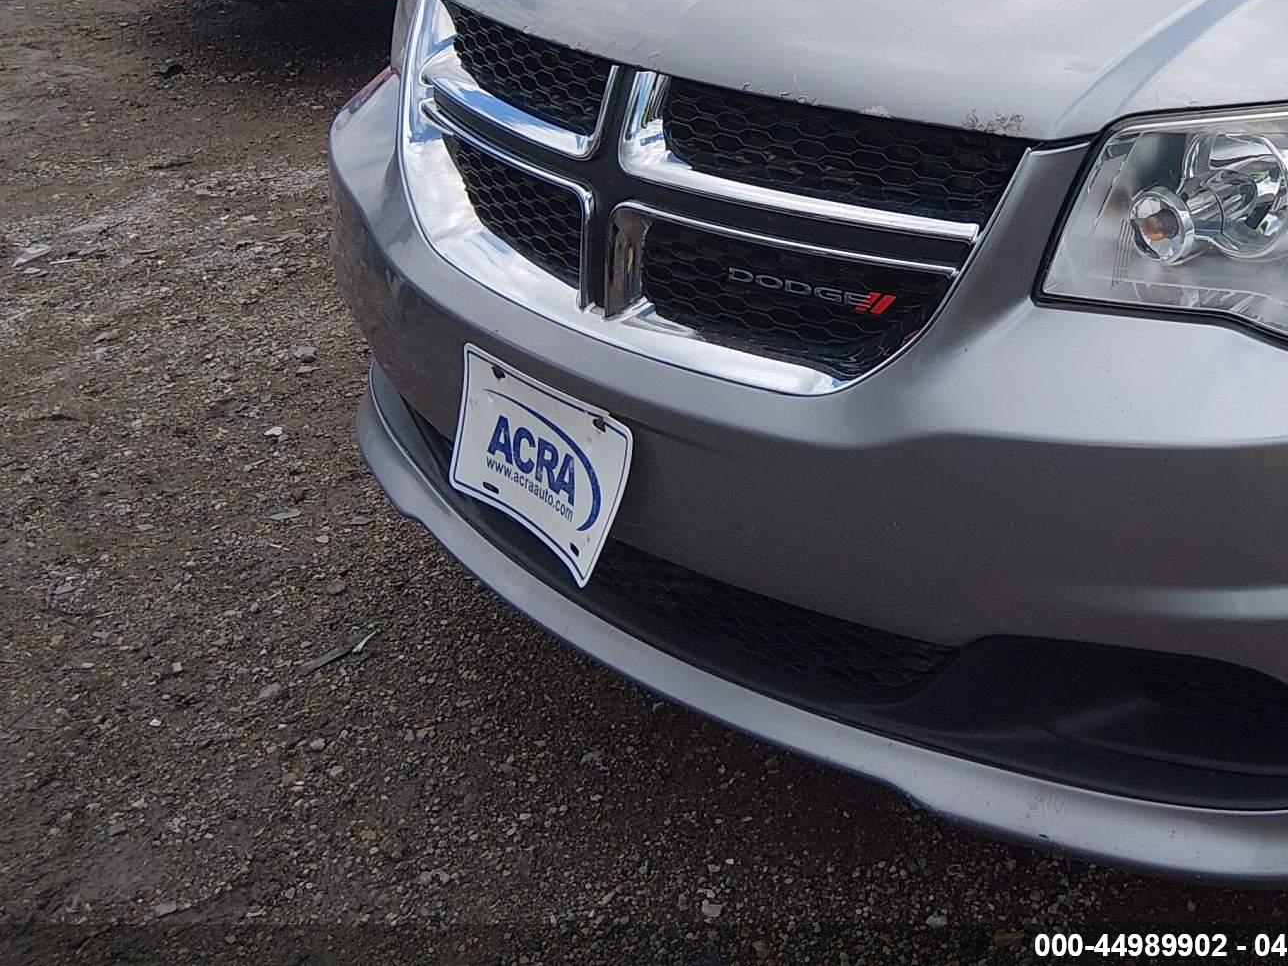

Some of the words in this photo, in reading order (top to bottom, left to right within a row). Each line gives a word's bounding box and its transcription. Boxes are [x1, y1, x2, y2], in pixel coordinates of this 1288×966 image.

[728, 267, 872, 308] DODGE
[485, 456, 574, 523] www.acraauto.com
[486, 414, 576, 508] ACRA
